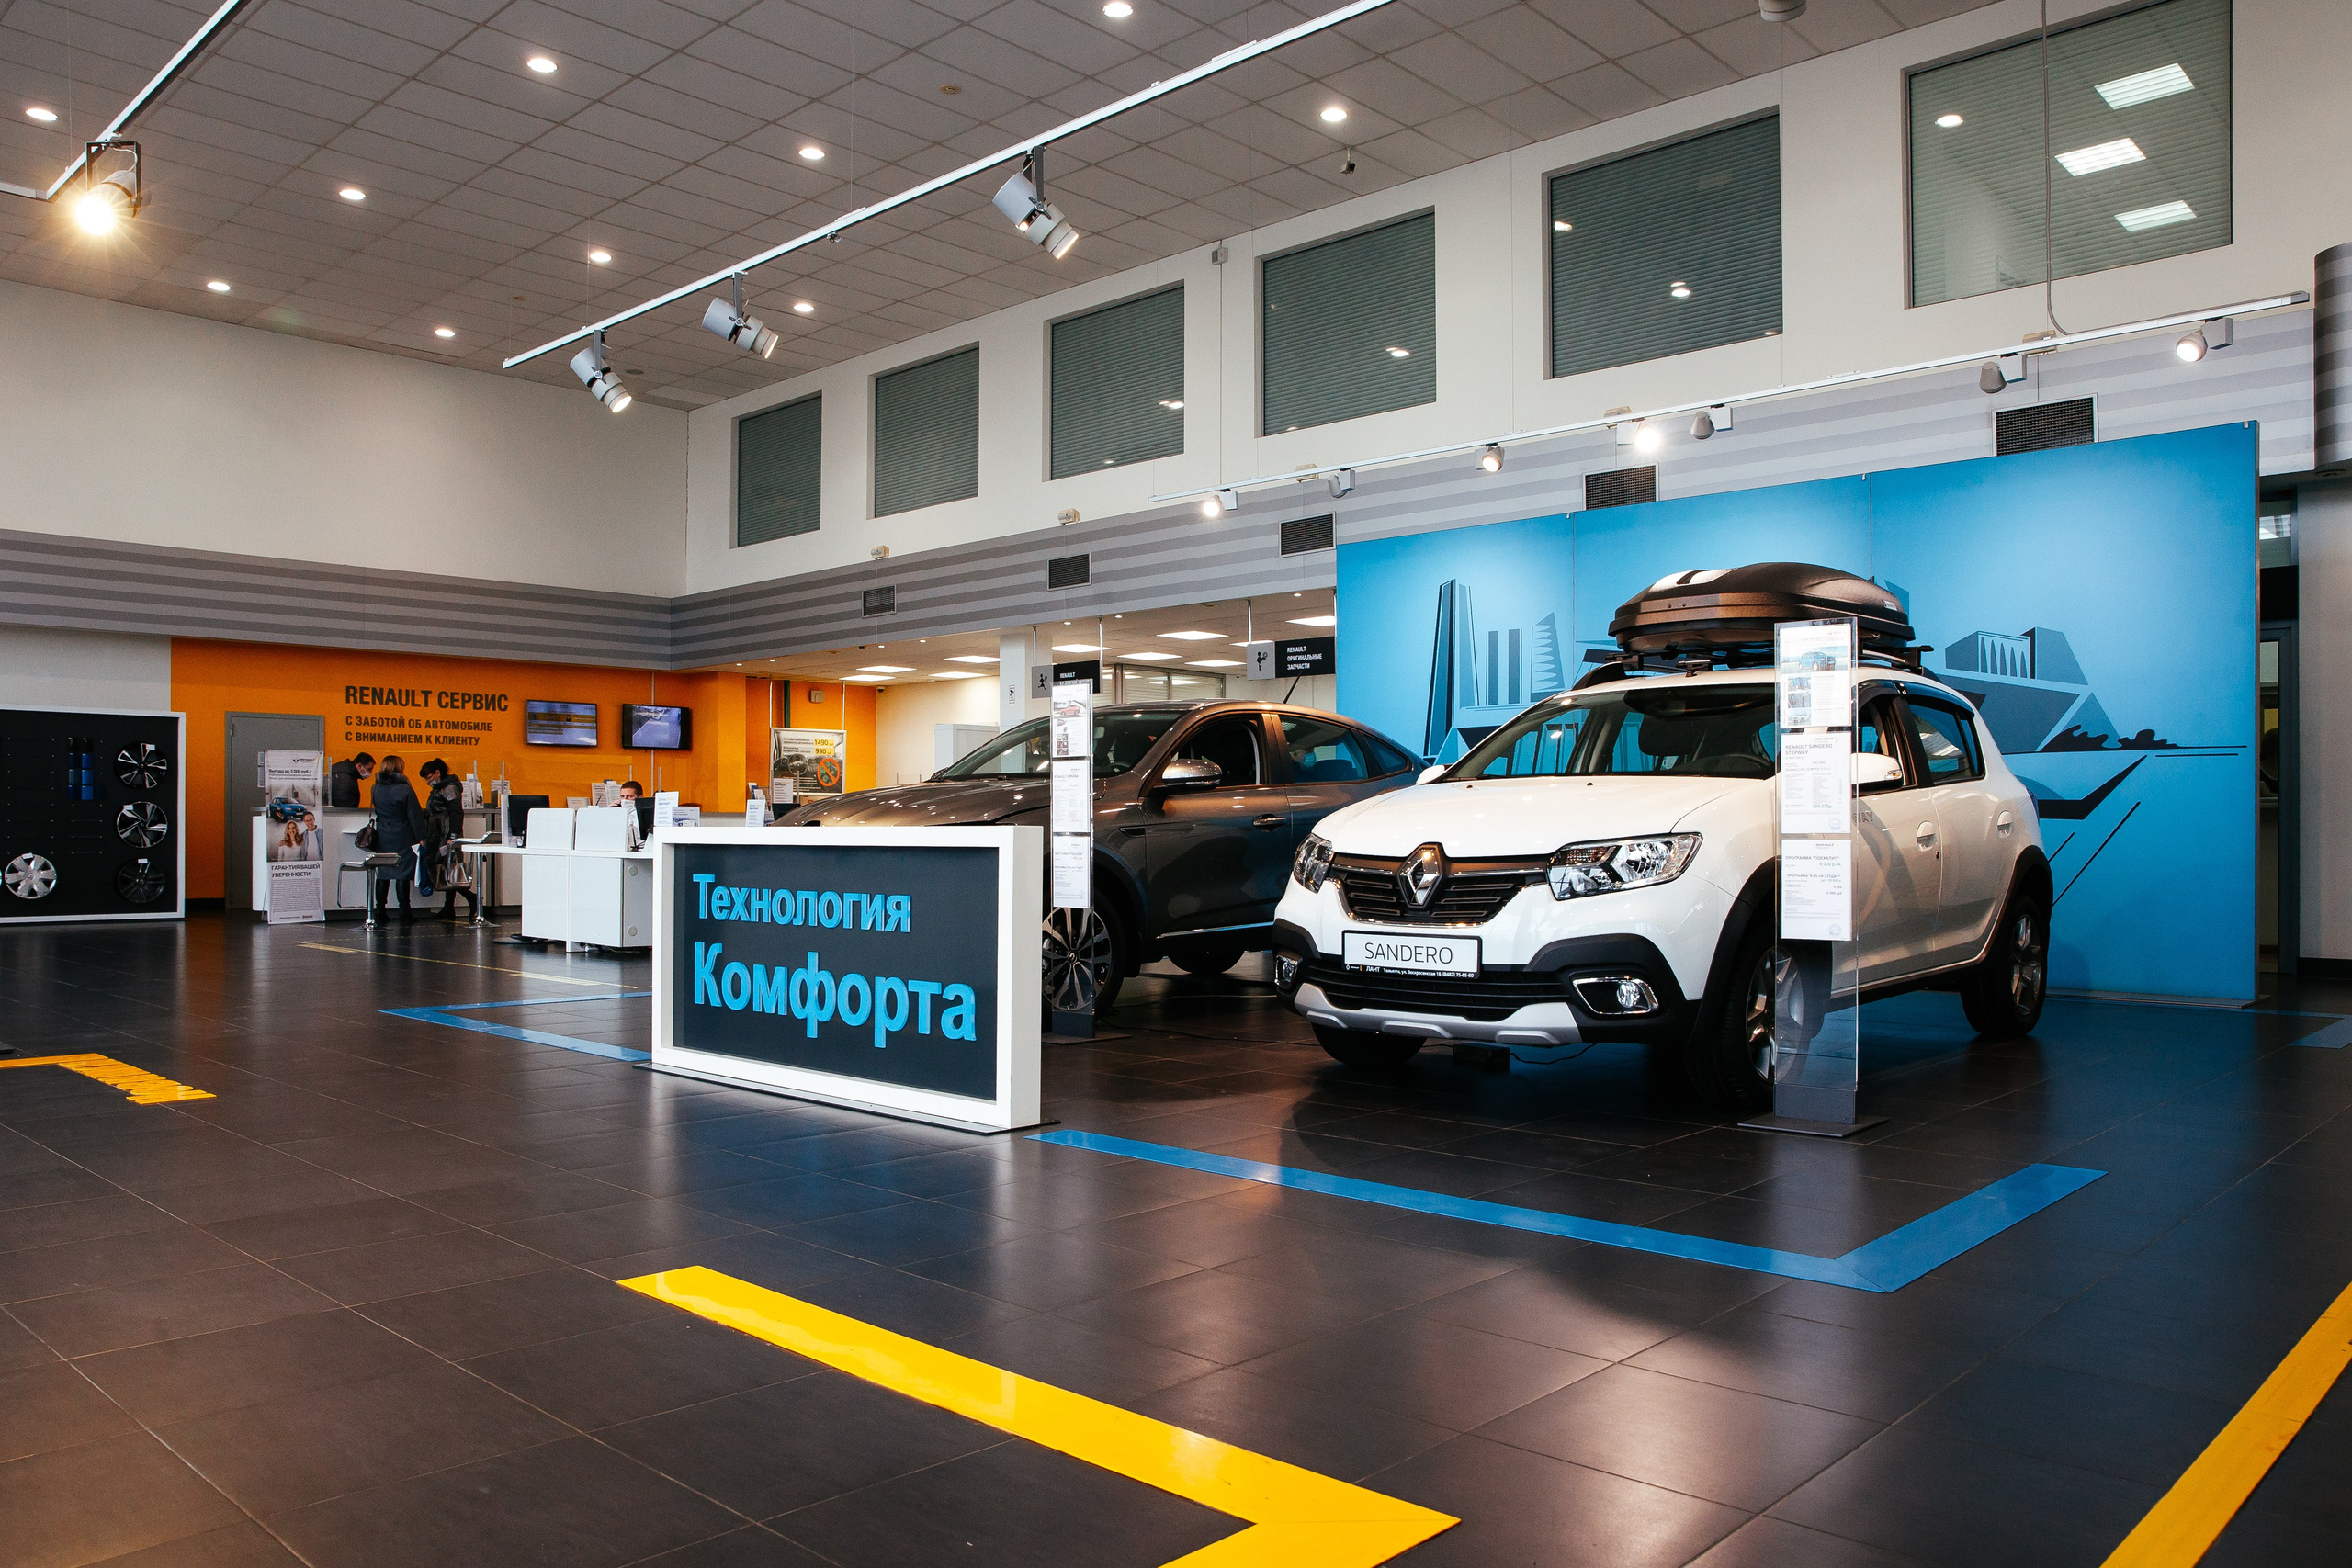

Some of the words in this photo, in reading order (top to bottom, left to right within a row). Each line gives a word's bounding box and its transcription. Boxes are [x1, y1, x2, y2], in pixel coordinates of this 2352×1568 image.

[345, 685, 432, 708] RENAULT
[437, 691, 509, 712] СЕРВИС
[345, 716, 352, 726] С
[356, 716, 405, 728] ЗАБОТОЙ
[408, 719, 422, 728] ОБ
[424, 720, 492, 732] АВТОМОБИЛЕ
[345, 731, 352, 741] С
[356, 732, 423, 744] ВНИМАНИЕМ
[425, 735, 433, 744] К
[435, 736, 480, 746] КЛИЕНТУ
[693, 874, 910, 932] Технология
[1364, 942, 1453, 964] SANDERO
[694, 942, 977, 1048] Комфорта
